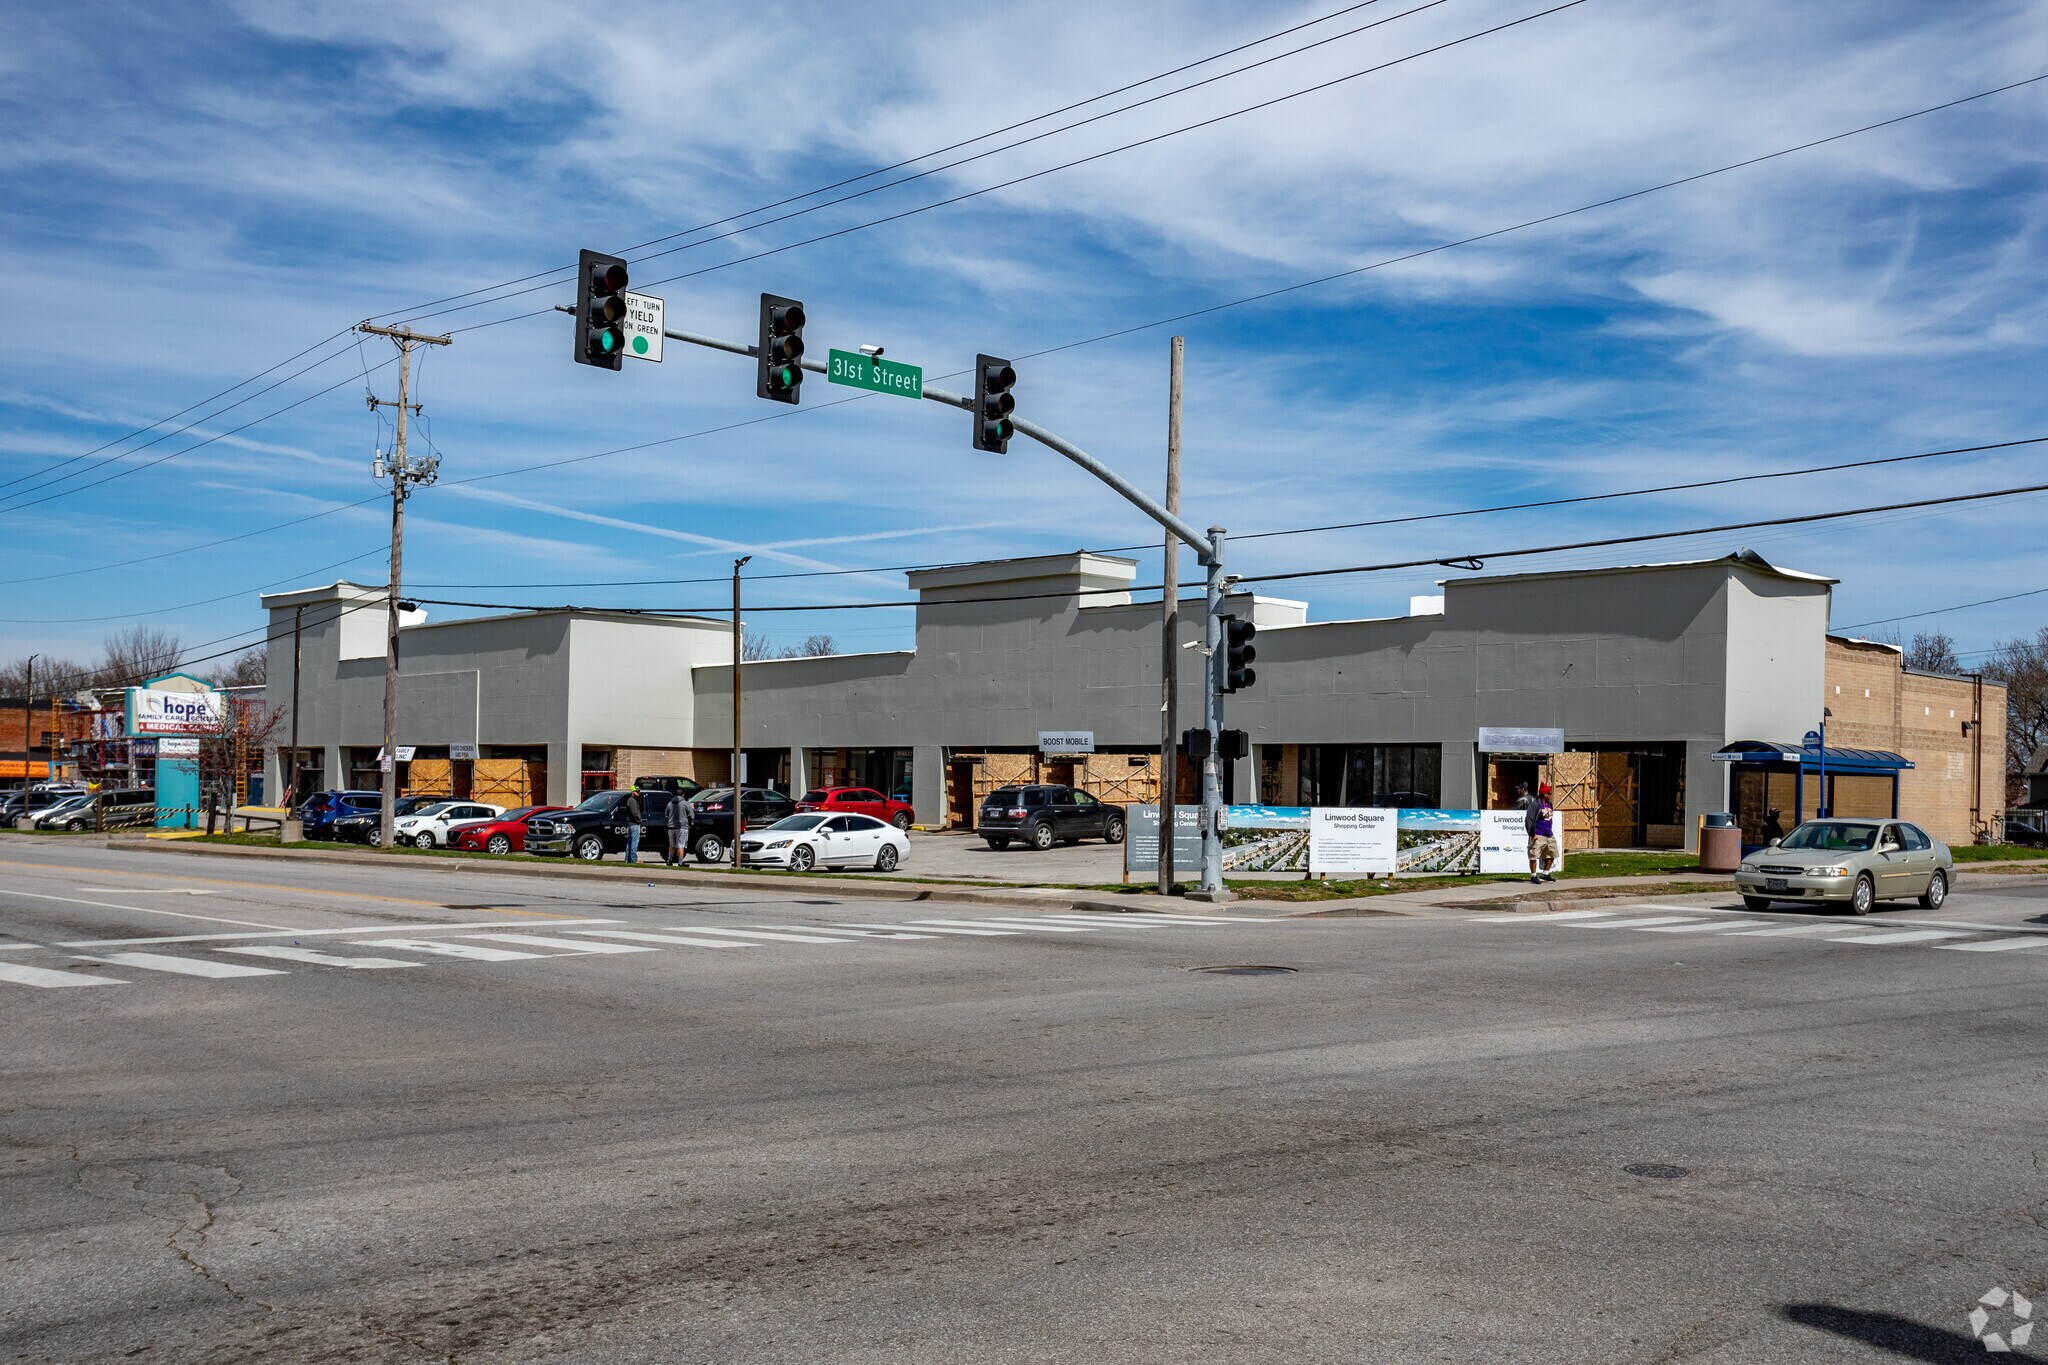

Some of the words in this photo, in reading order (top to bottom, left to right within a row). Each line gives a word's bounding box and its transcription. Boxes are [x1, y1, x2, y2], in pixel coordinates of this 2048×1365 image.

[626, 297, 638, 307] EFT
[643, 301, 661, 311] TURN
[629, 309, 654, 323] YIELD
[637, 324, 659, 335] GREEN
[833, 358, 863, 380] 31st
[872, 366, 918, 391] Street
[164, 696, 206, 722] hope
[164, 714, 185, 722] CARE
[146, 723, 186, 731] MEDICAL
[1043, 738, 1064, 746] BOOST
[1065, 737, 1089, 746] MOBILE
[1325, 813, 1357, 821] Linwood
[1358, 813, 1385, 822] Square
[1493, 815, 1523, 823] Linwood
